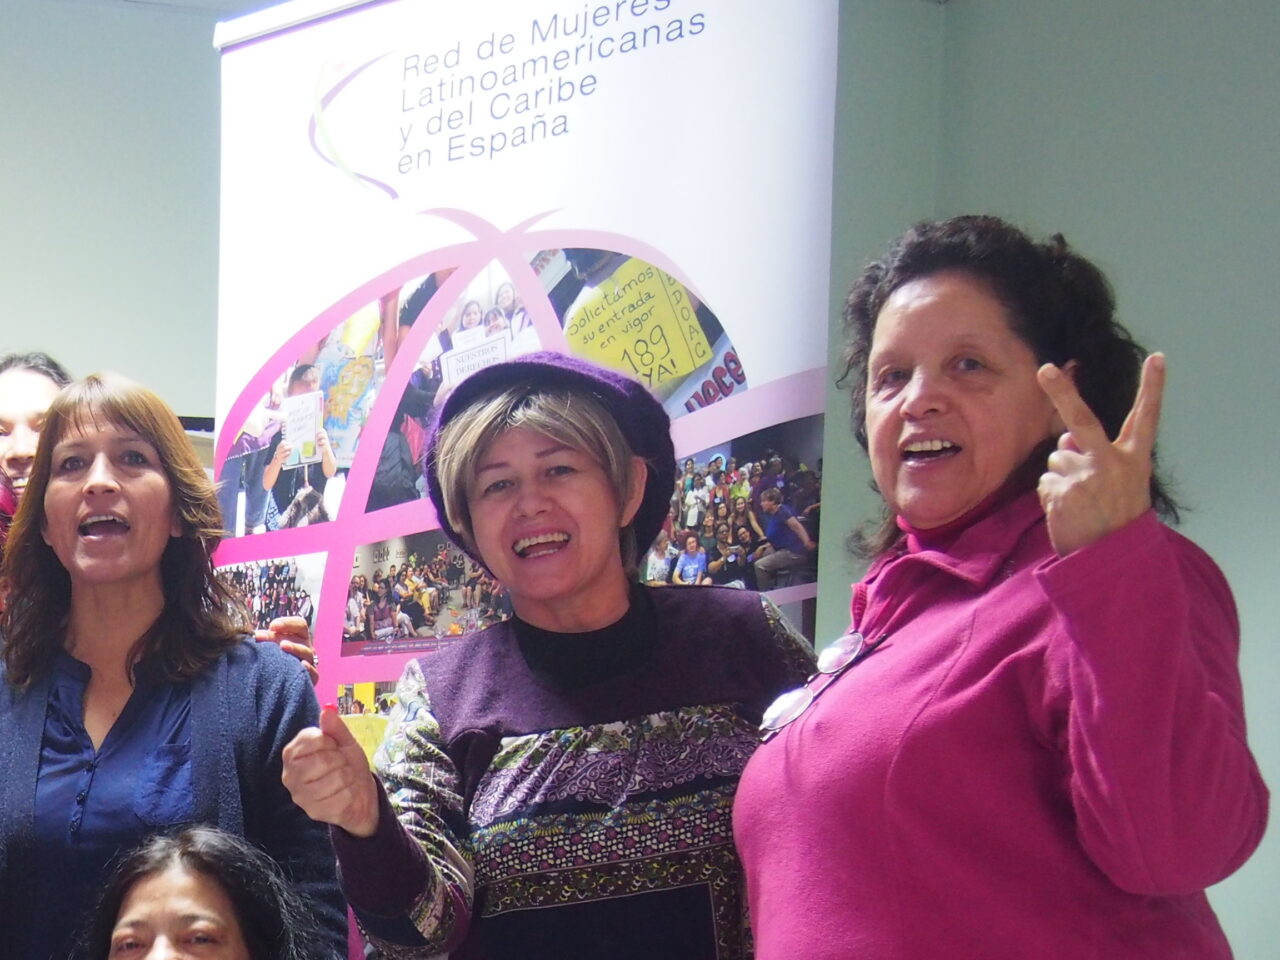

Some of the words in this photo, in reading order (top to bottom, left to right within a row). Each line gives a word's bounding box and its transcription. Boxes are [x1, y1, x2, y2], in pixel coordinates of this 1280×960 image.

[402, 12, 706, 112] Latinoamericanas
[403, 41, 461, 81] Red
[477, 32, 515, 60] de
[531, 0, 672, 45] Mujeres
[399, 122, 413, 151] y
[426, 100, 472, 135] del
[490, 74, 597, 120] Caribe
[398, 148, 431, 174] en
[448, 113, 569, 162] España
[598, 290, 656, 334] entrada
[600, 334, 616, 349] en
[621, 305, 656, 336] vigor
[621, 324, 670, 374] 189
